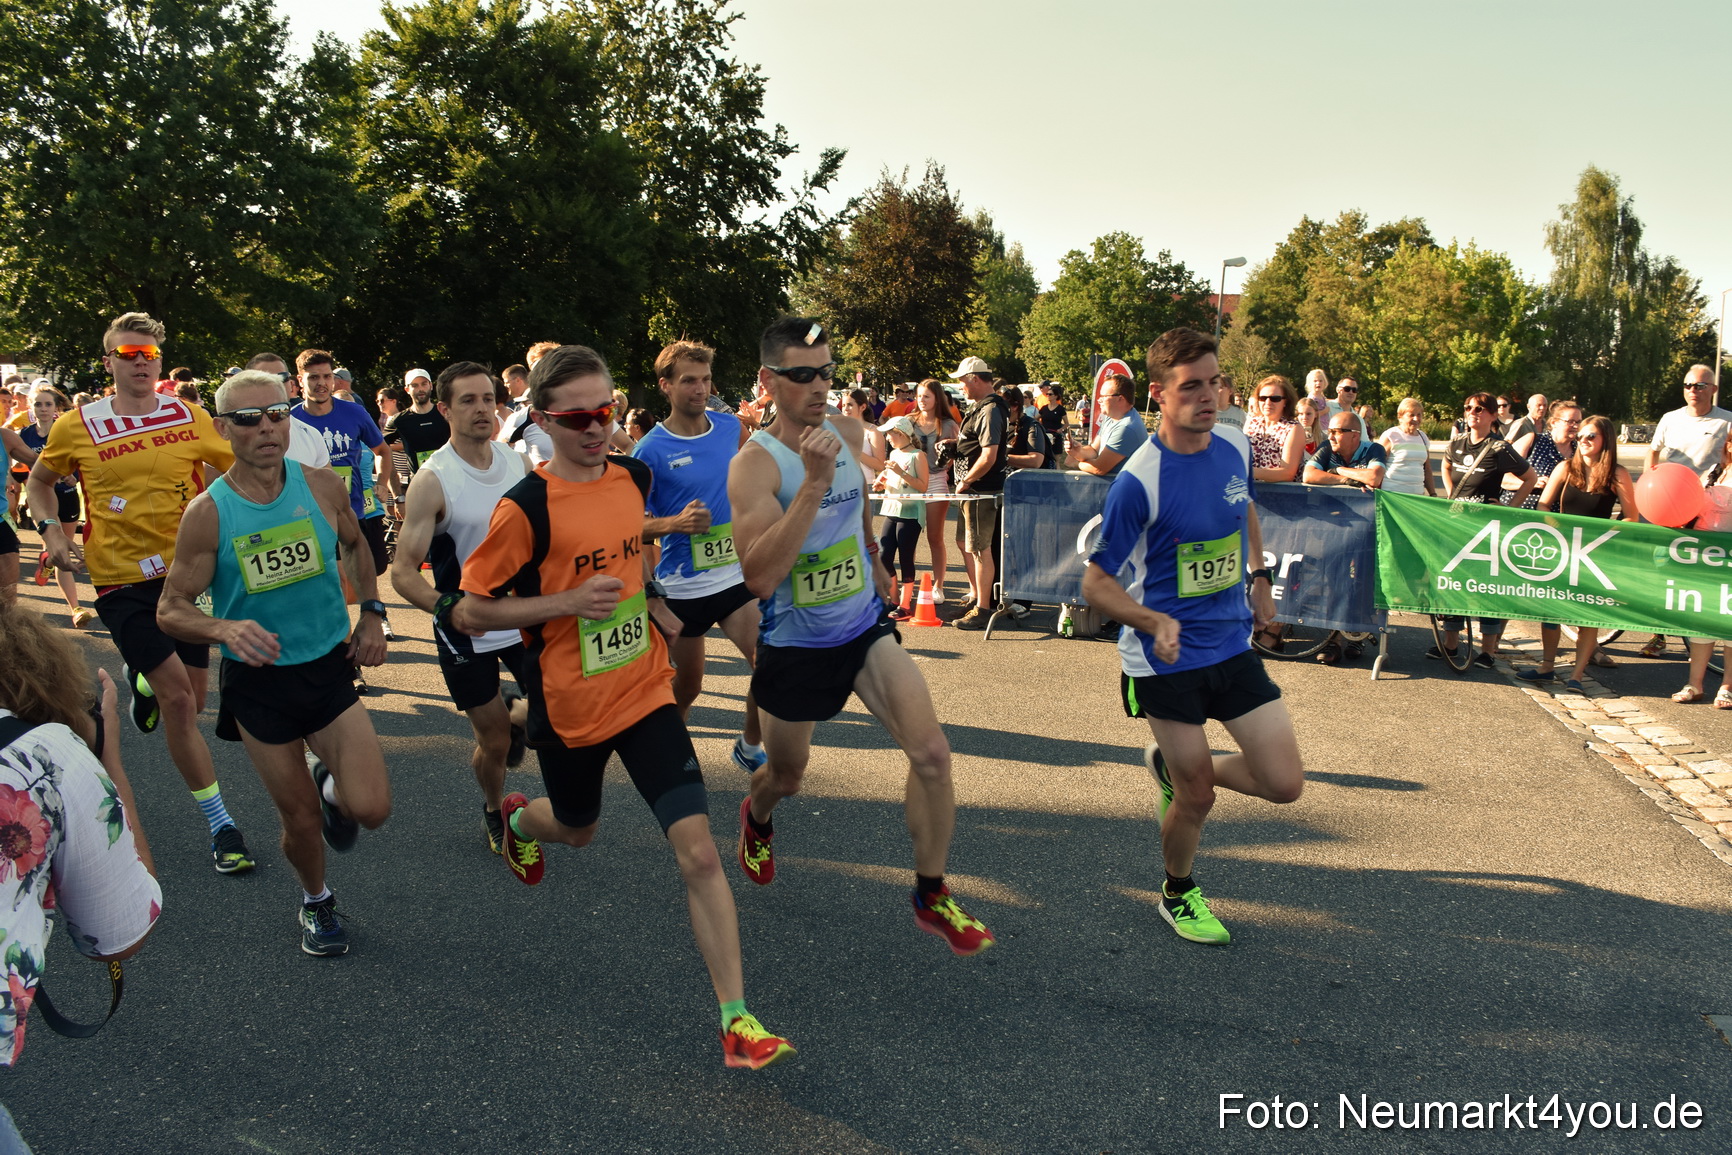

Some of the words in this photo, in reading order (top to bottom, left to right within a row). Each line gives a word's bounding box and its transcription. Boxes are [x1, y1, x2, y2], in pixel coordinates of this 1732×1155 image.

[98, 439, 148, 462] MAX
[151, 430, 200, 448] BÖGL
[250, 541, 311, 575] 1539
[704, 537, 734, 558] 812
[1442, 520, 1621, 591] AOK
[1668, 536, 1732, 567] Ge
[265, 570, 284, 580] Heinz
[284, 564, 304, 574] Andrei
[803, 558, 857, 592] 1775
[1188, 552, 1236, 581] 1975
[1437, 576, 1463, 592] Die
[1466, 578, 1620, 607] Gesundheitskasse.
[1665, 579, 1702, 613] in
[591, 616, 643, 655] 1488
[598, 651, 618, 663] Sturm
